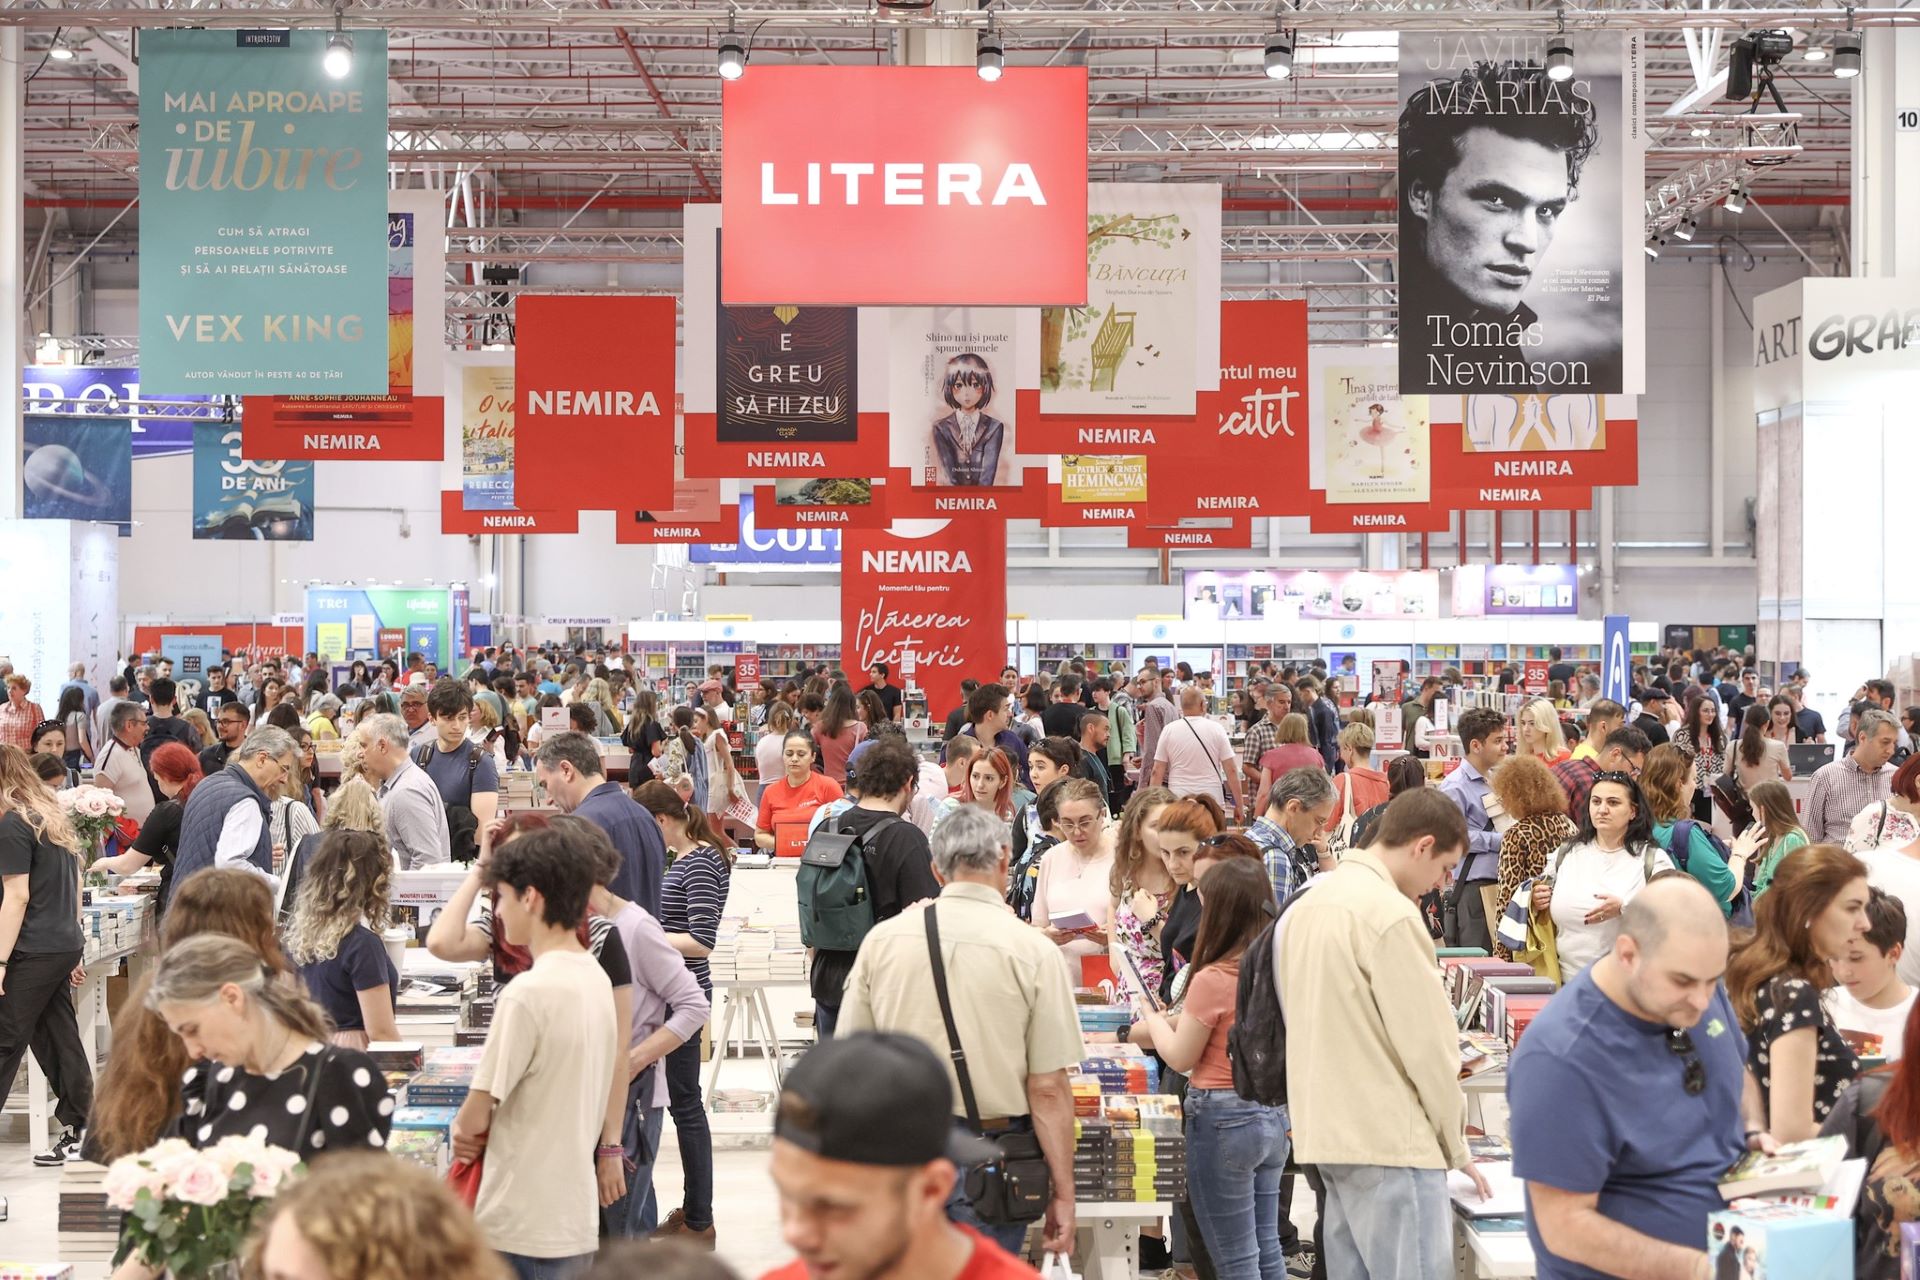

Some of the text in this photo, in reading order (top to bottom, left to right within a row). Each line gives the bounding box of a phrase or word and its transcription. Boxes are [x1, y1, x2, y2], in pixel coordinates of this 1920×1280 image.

[1425, 36, 1545, 70] JAVIE
[164, 91, 363, 113] MAI APROAPE
[1425, 74, 1592, 116] MARÍAS
[1898, 112, 1918, 128] 10
[195, 120, 232, 142] DE
[165, 120, 363, 191] iubire
[761, 162, 1048, 206] LITERA
[218, 226, 310, 237] CUM SĂ ATRAGI
[194, 246, 334, 255] PERSOANELE POTRIVITE
[195, 263, 210, 274] SĂ
[215, 265, 227, 274] AI
[279, 263, 348, 274] SĂNĂTOASE
[1095, 263, 1188, 286] BĂNCUȚA
[165, 314, 365, 342] VEX KING
[1426, 314, 1544, 347] Tomás
[780, 333, 792, 351] E
[925, 333, 952, 342] Shino
[983, 333, 1009, 344] poate
[1755, 316, 1802, 367] ART
[935, 344, 999, 354] spune numele
[185, 371, 214, 379] AUTOR
[268, 371, 292, 379] PESTE
[295, 371, 307, 379] 40
[310, 371, 321, 379] DE
[748, 365, 822, 383] GREU
[1220, 364, 1297, 379] ntul meu
[1426, 353, 1591, 385] Nevinson
[1338, 376, 1367, 395] Tina
[479, 394, 494, 413] O
[528, 390, 661, 416] NEMIRA
[735, 394, 839, 415] SĂ FII ZEU
[1219, 385, 1300, 439] citit
[303, 434, 381, 450] NEMIRA
[1078, 428, 1156, 444] NEMIRA
[220, 431, 287, 475] 3
[747, 452, 826, 467] NEMIRA
[1494, 460, 1573, 477] NEMIRA
[221, 477, 286, 490] DE ANI
[1197, 497, 1260, 509] NEMIRA
[1479, 489, 1542, 501] NEMIRA
[935, 498, 997, 510] NEMIRA
[483, 515, 536, 527] NEMIRA
[796, 511, 849, 522] NEMIRA
[1083, 508, 1136, 519] NEMIRA
[1353, 515, 1407, 527] NEMIRA
[653, 527, 701, 538] NEMIRA
[1165, 533, 1213, 544] NEMIRA
[862, 549, 973, 573] NEMIRA
[878, 584, 913, 592] Momentul
[926, 585, 950, 593] pentru
[569, 617, 611, 625] PUBLISHING
[855, 596, 971, 652] plăcerea
[739, 663, 757, 677] 35
[1528, 668, 1546, 680] 35
[791, 840, 808, 848] LIT
